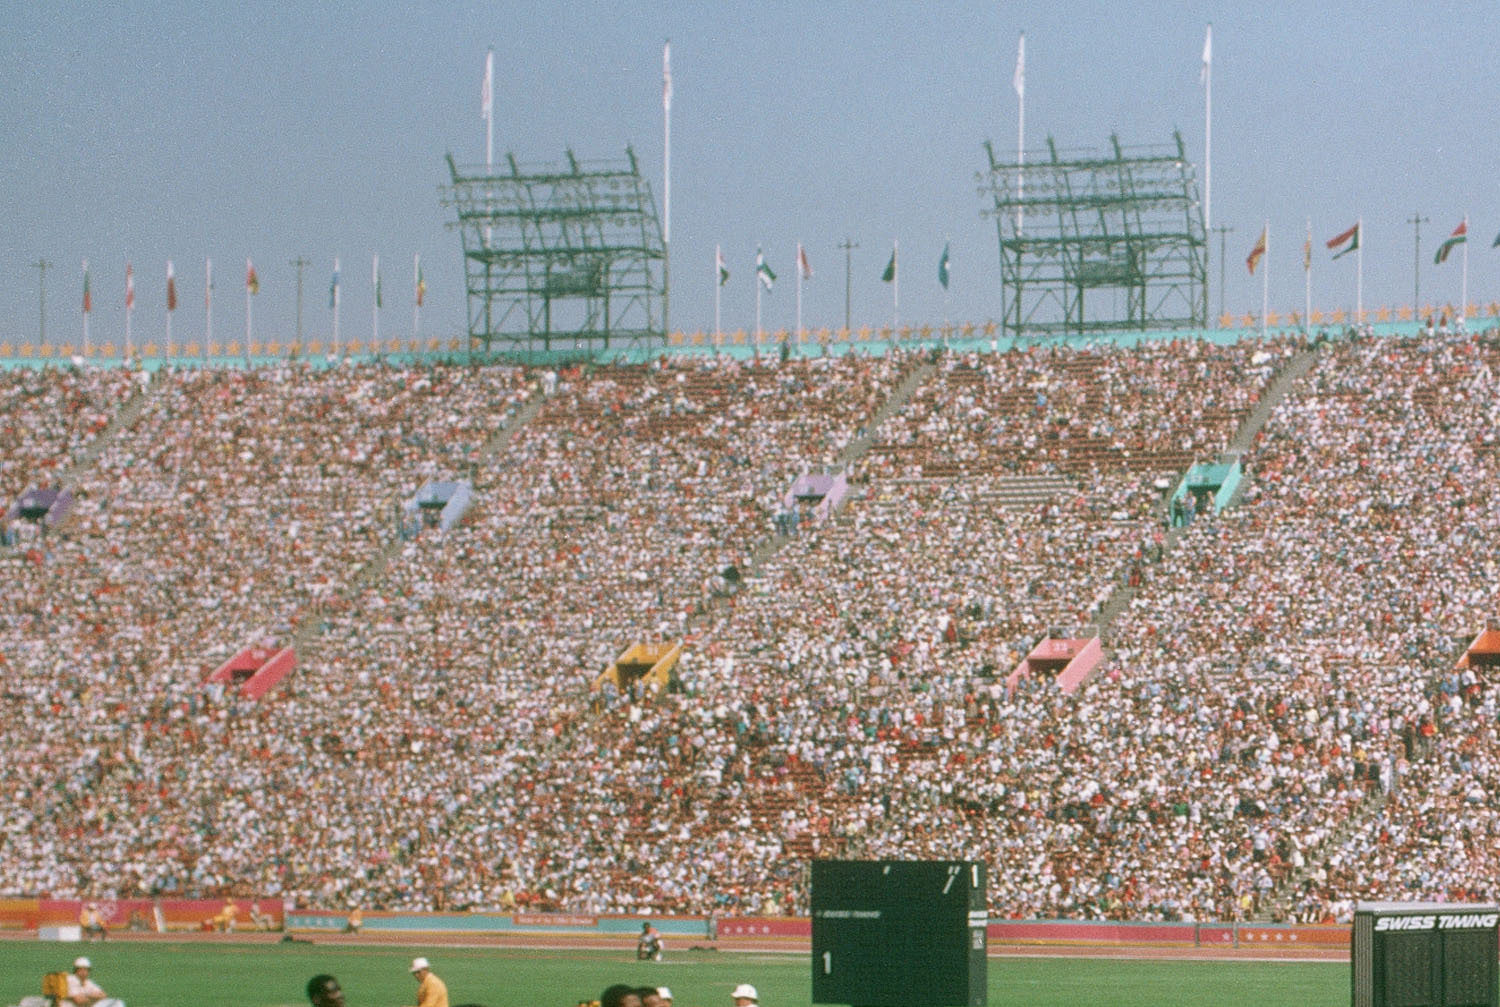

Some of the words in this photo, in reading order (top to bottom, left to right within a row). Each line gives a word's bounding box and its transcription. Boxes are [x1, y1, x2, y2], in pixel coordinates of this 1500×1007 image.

[1375, 916, 1436, 931] SWISS
[1438, 915, 1498, 929] TIMING
[823, 951, 832, 975] 1
